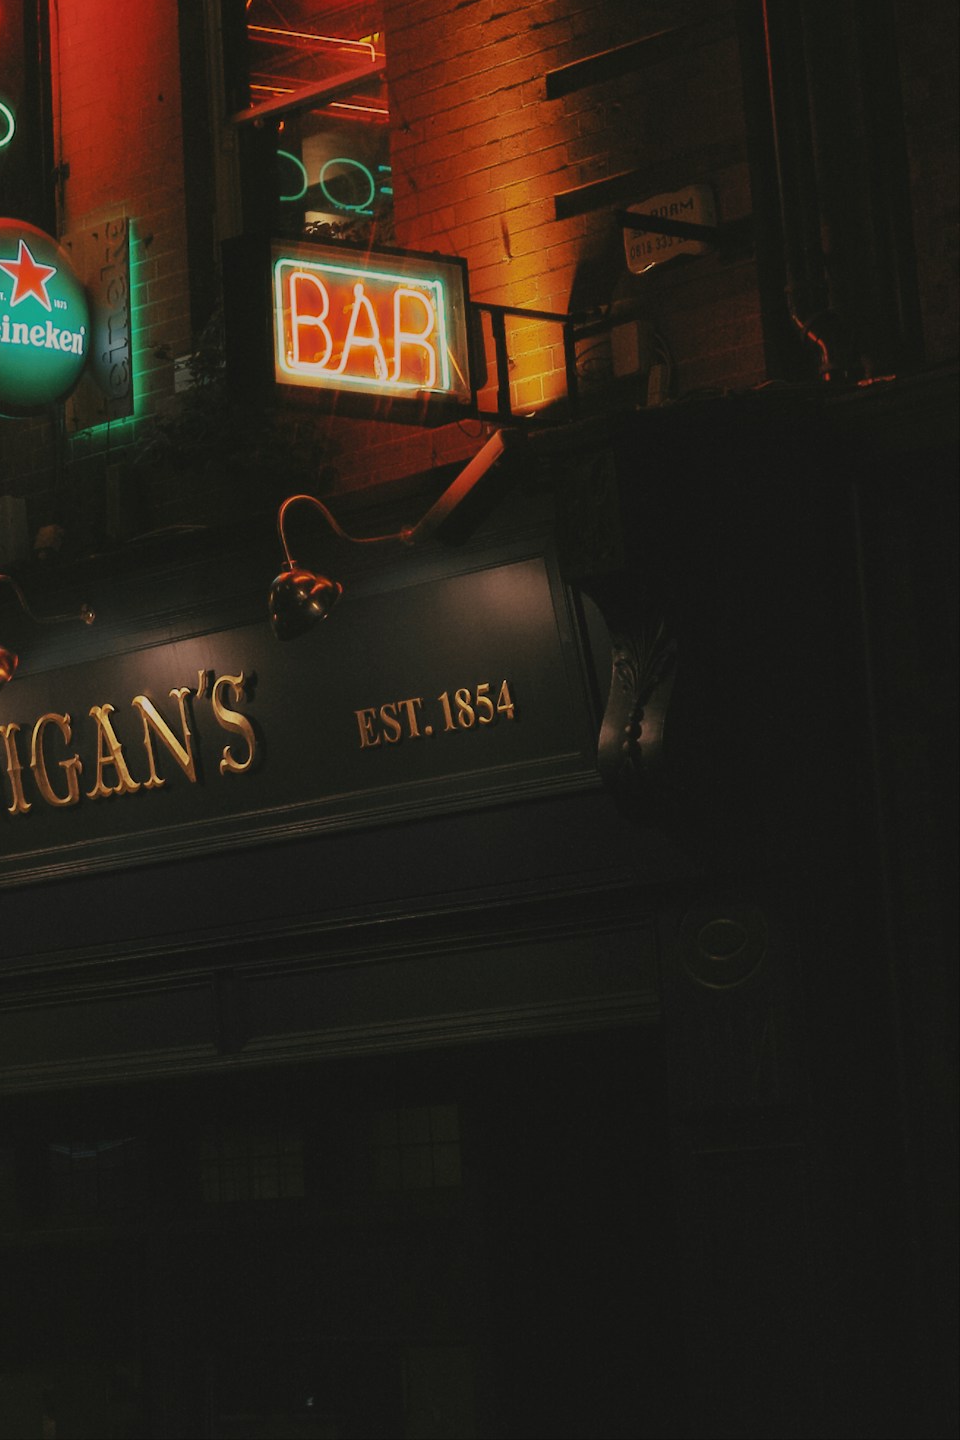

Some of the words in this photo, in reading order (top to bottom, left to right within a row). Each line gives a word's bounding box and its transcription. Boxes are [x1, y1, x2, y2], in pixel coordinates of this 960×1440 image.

[288, 271, 437, 389] BAR
[353, 696, 434, 749] EST.
[437, 678, 515, 732] 1854
